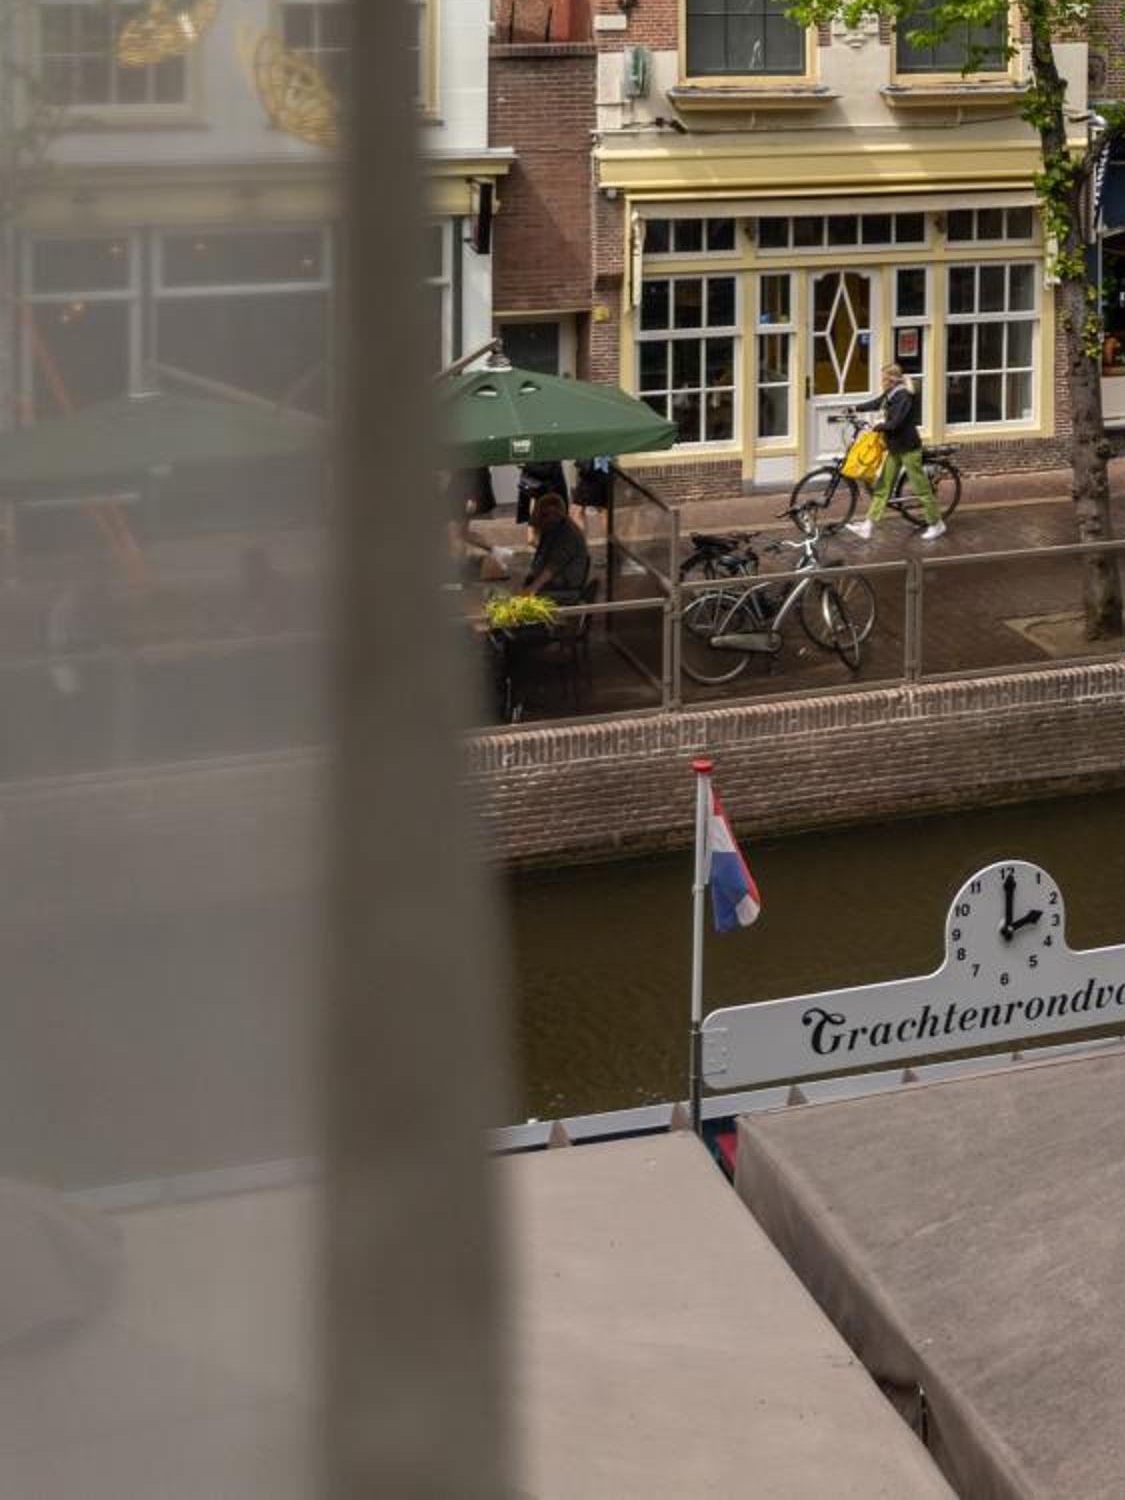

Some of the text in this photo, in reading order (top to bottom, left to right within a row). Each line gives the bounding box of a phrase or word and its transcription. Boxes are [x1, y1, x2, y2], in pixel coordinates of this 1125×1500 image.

[1036, 871, 1041, 884] 1
[970, 881, 981, 893] 11
[1049, 892, 1058, 905] 2
[955, 903, 971, 917] 10
[1051, 913, 1060, 927] 3
[951, 929, 961, 941] 9
[1043, 935, 1052, 947] 4
[957, 948, 966, 961] 8
[1029, 954, 1038, 968] 5
[972, 963, 980, 977] 7
[1000, 972, 1009, 986] 6
